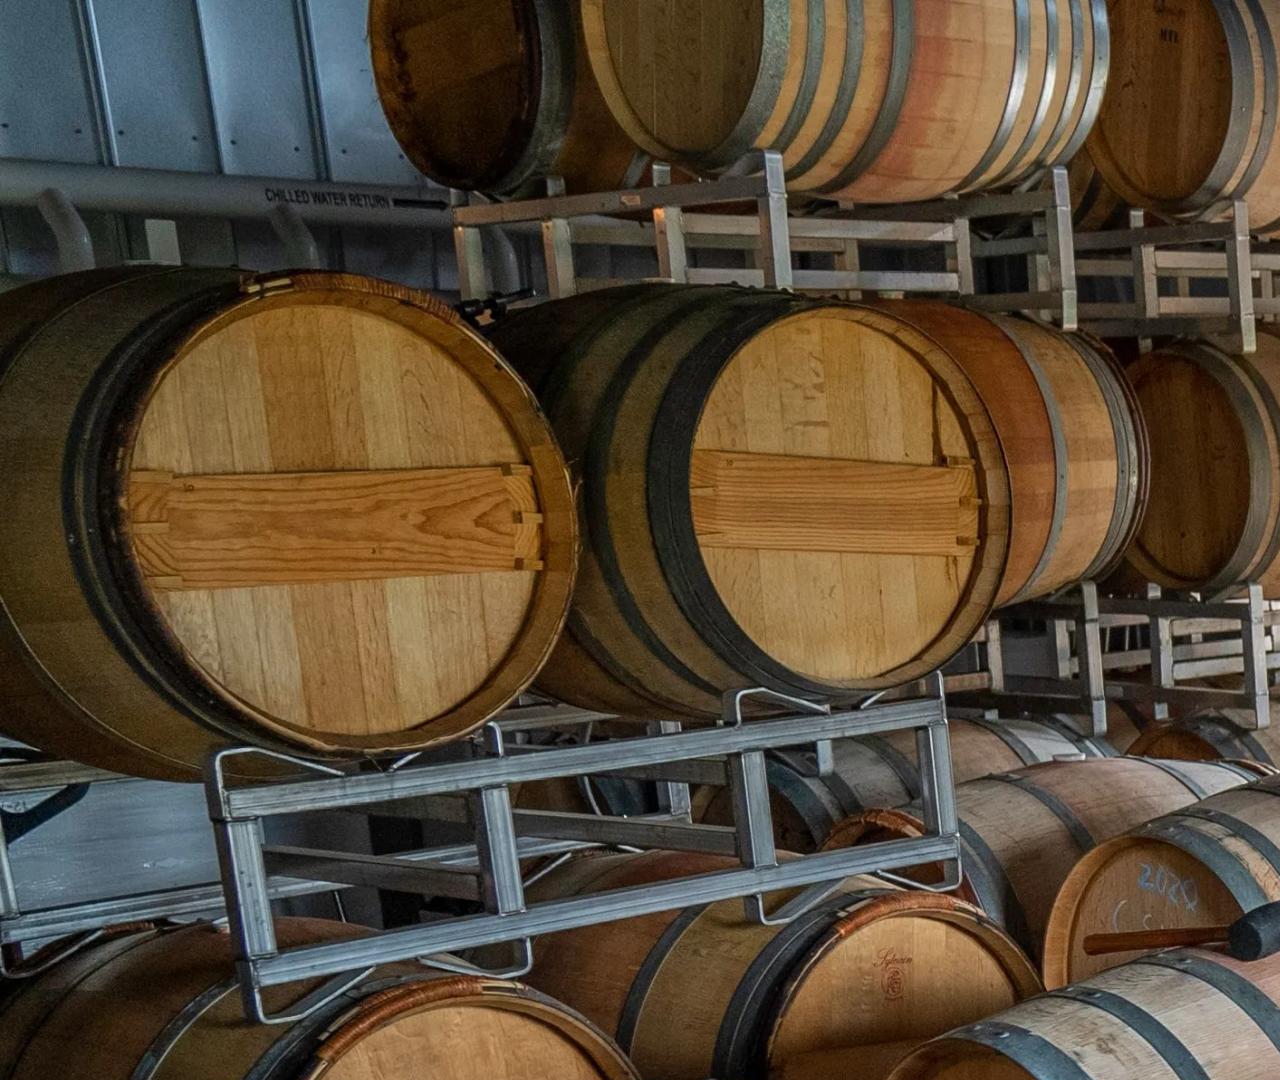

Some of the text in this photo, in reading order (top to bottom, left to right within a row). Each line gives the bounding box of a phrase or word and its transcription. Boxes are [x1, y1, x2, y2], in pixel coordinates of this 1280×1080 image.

[264, 188, 390, 208] CHILLED WATER RETURN
